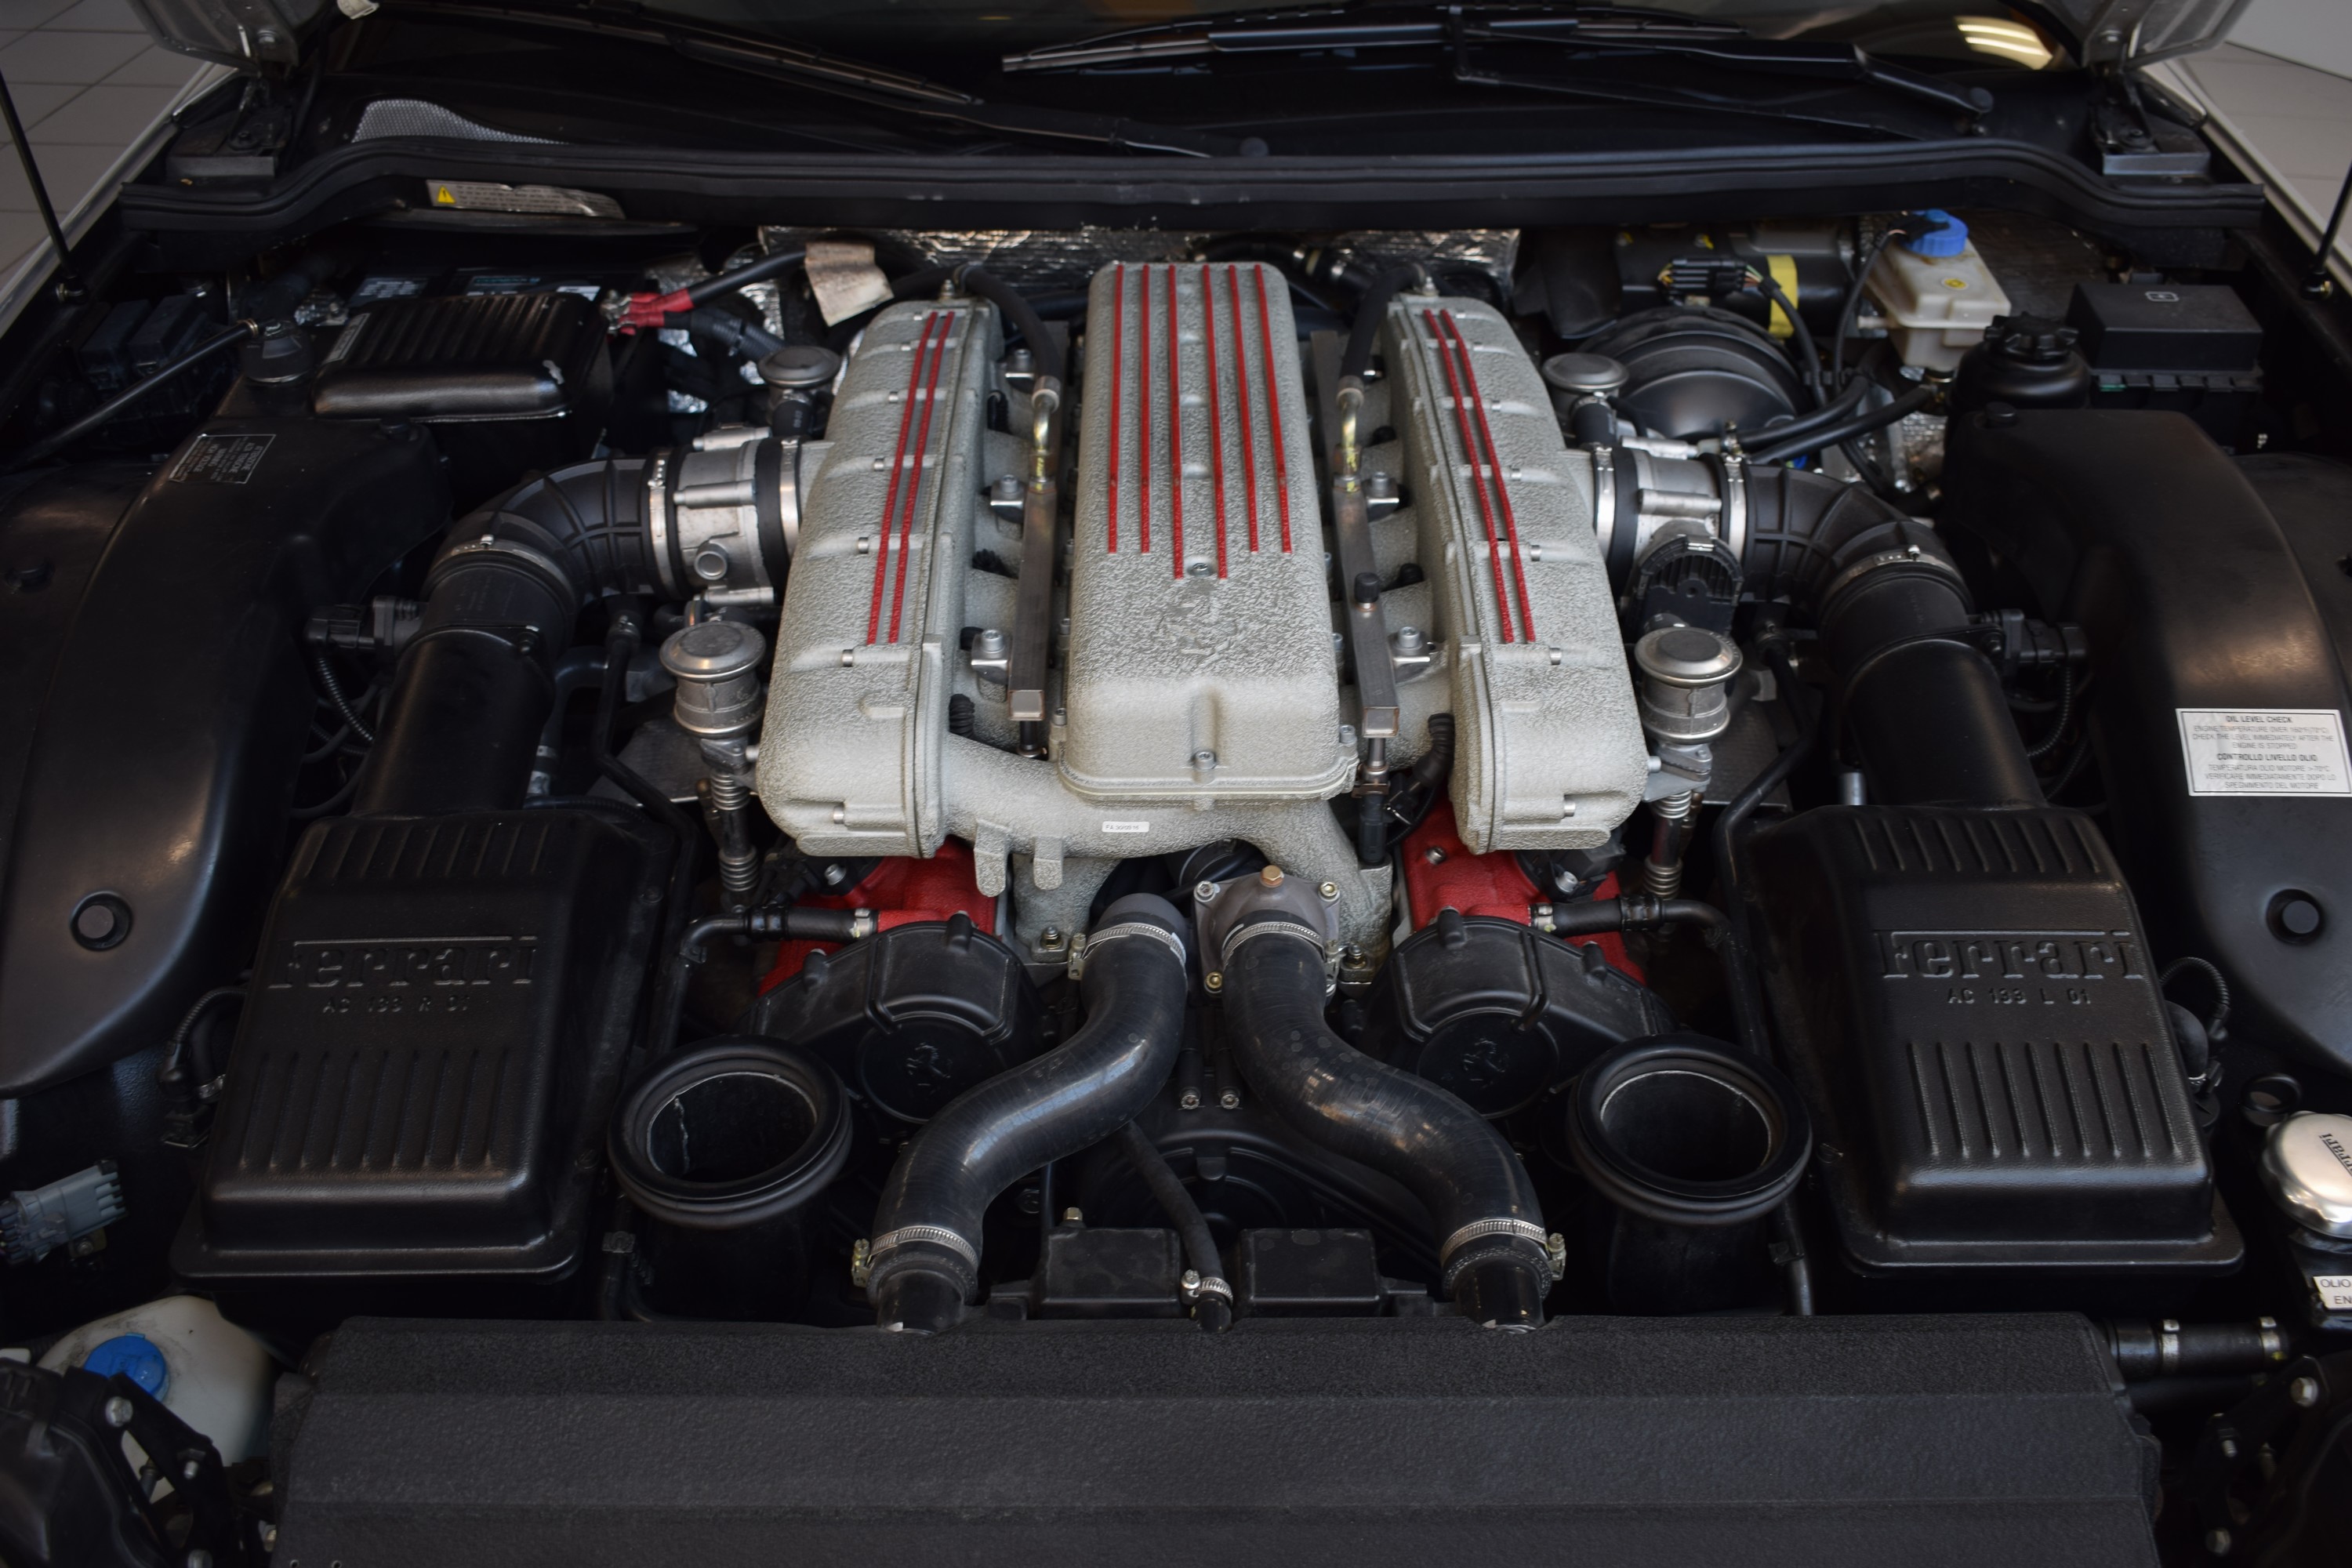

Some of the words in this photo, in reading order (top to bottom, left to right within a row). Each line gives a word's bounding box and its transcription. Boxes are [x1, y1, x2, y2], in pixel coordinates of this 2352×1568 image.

[267, 935, 539, 989] Ferrari
[1872, 929, 2145, 979] Ferrari
[367, 996, 403, 1013] 133
[419, 996, 432, 1012] R
[1947, 989, 1975, 1004] AC
[1988, 989, 2027, 1004] 133
[2040, 989, 2055, 1004] L
[2067, 988, 2092, 1004] 01
[2320, 1279, 2351, 1288] OLIO
